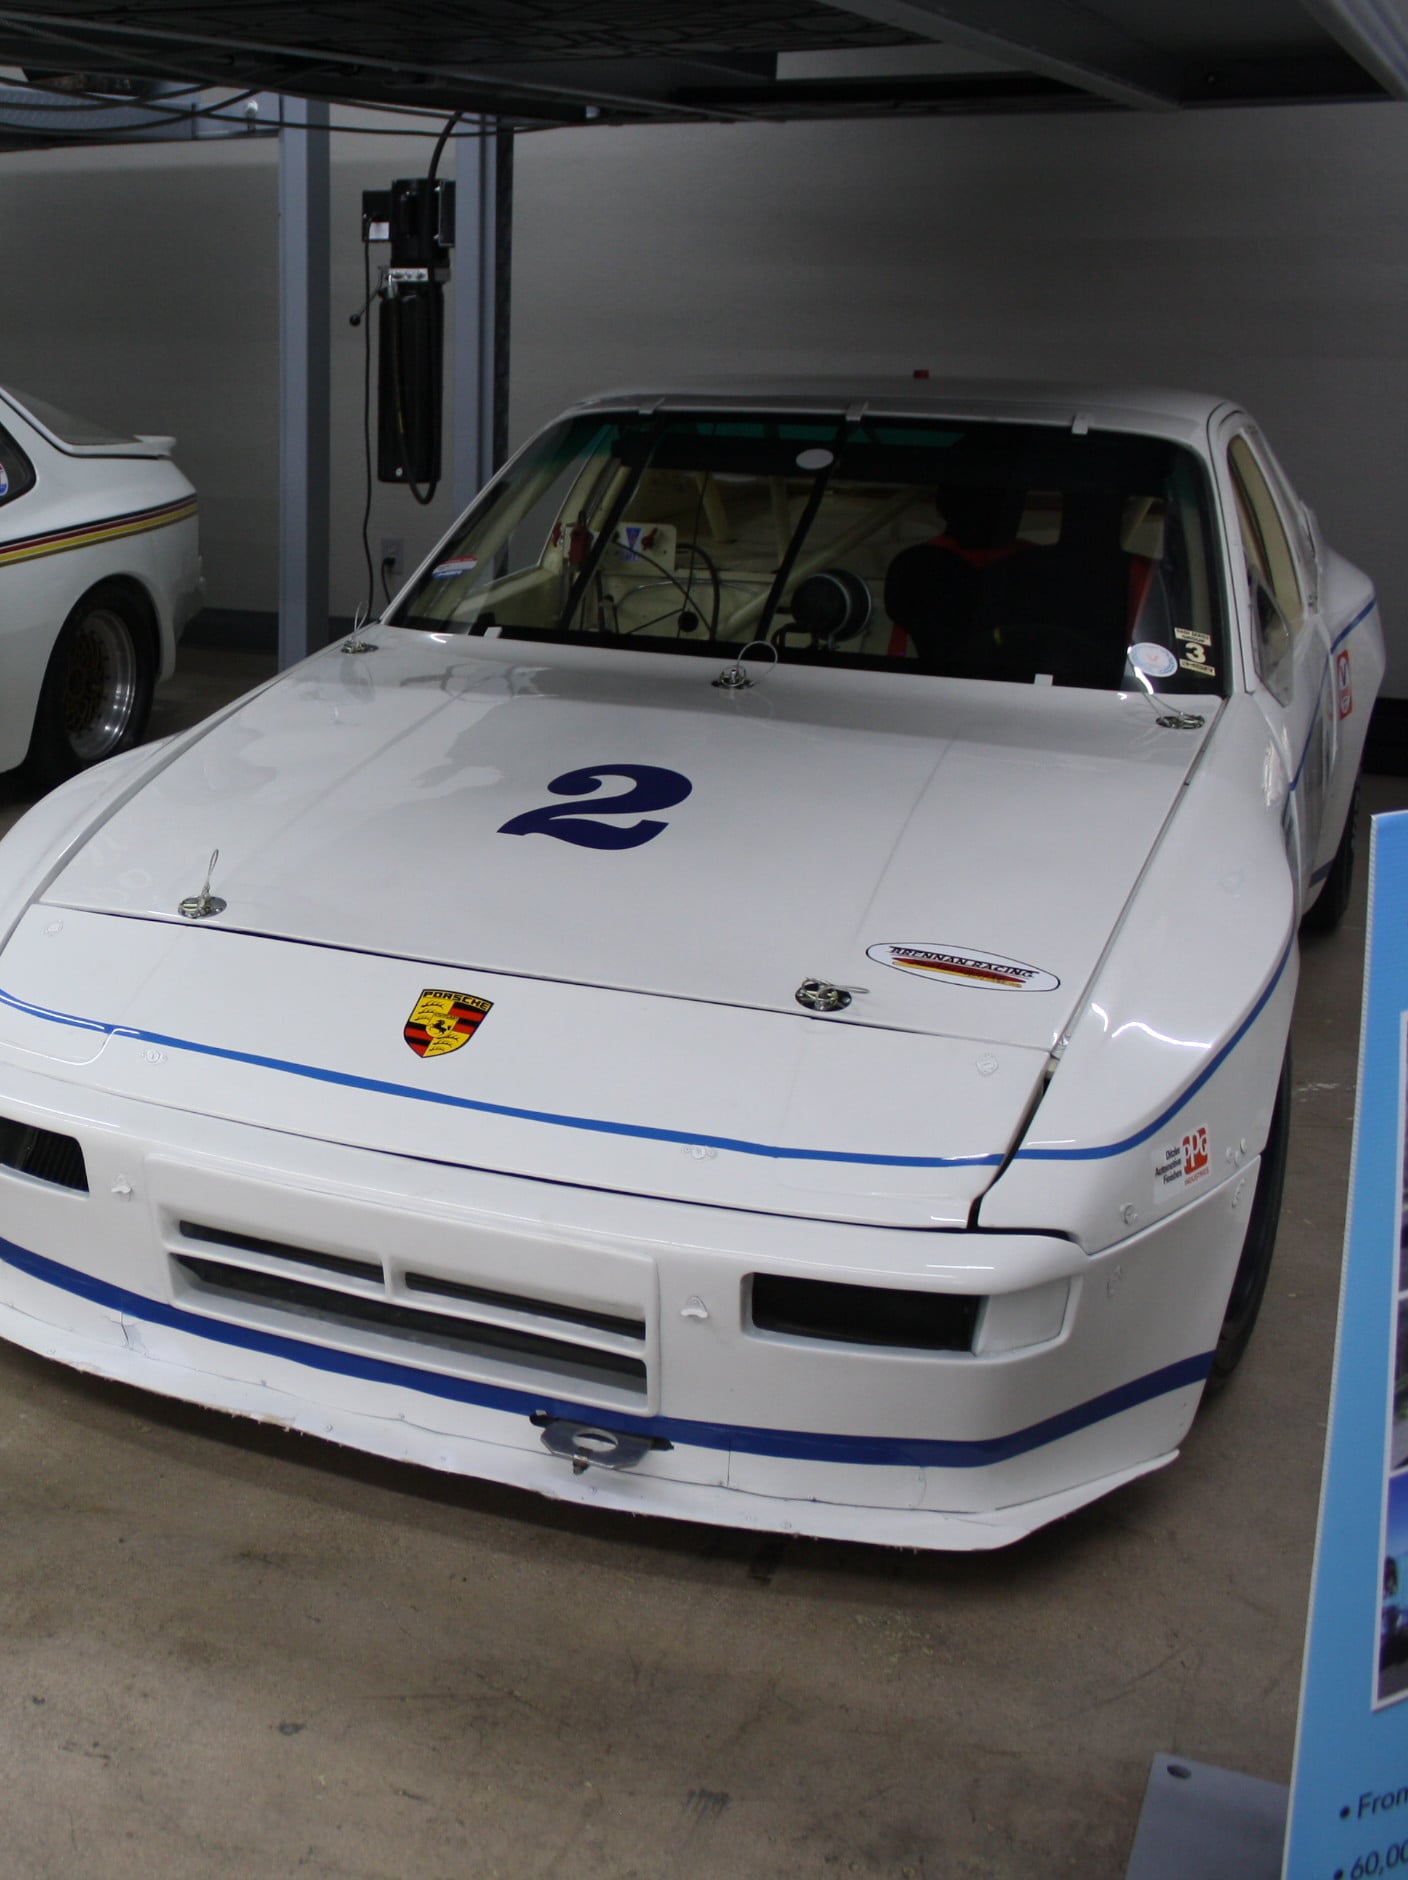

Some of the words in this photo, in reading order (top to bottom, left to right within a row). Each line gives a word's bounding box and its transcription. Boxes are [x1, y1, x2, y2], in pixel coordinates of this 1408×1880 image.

[1185, 642, 1206, 663] 3
[496, 764, 693, 850] 2
[890, 946, 967, 967] BRENNAN
[971, 961, 1039, 978] RACING
[423, 991, 491, 1012] PORSCHE
[1182, 1128, 1208, 1169] PPG
